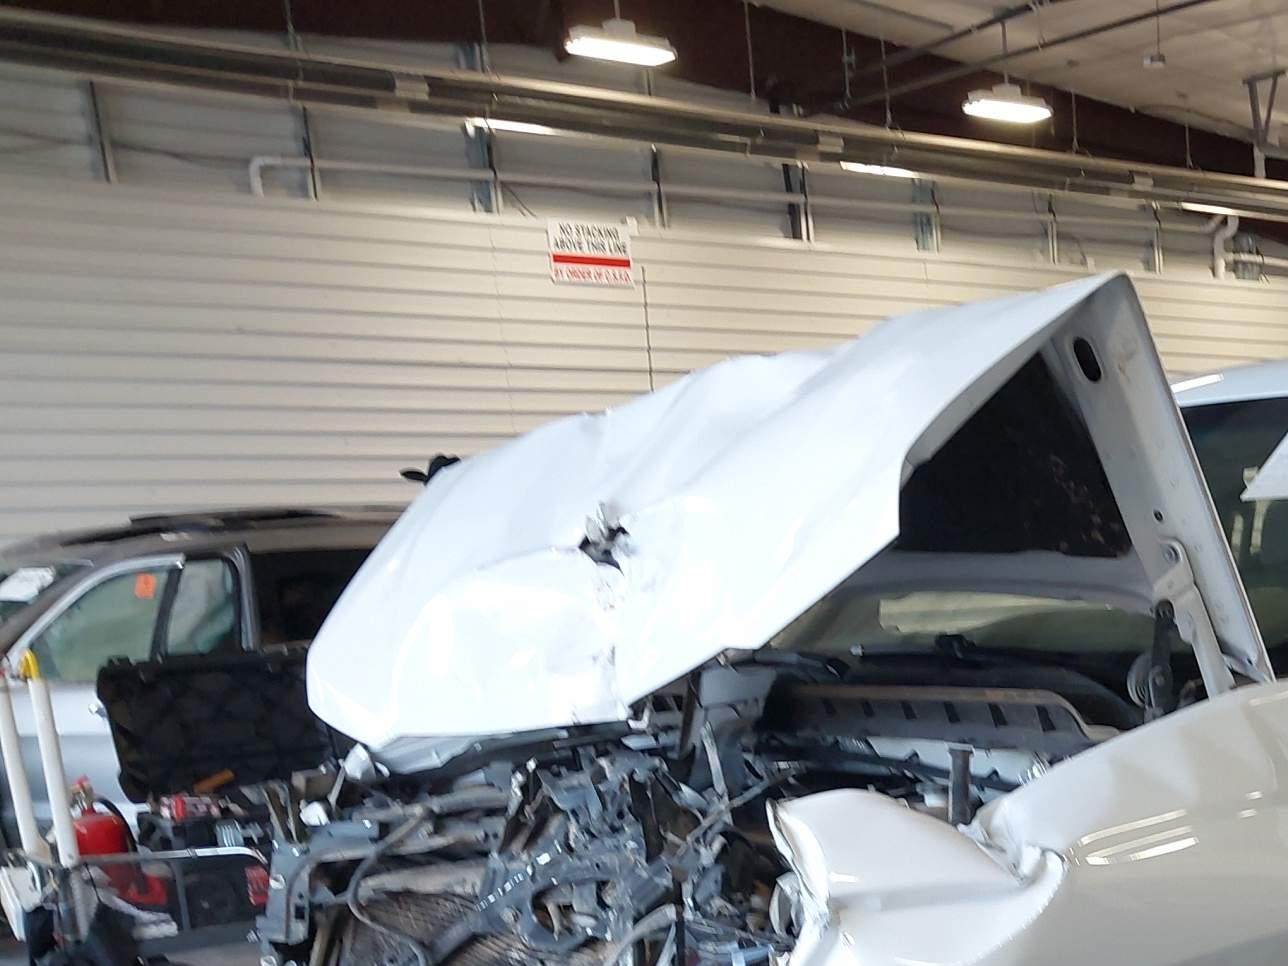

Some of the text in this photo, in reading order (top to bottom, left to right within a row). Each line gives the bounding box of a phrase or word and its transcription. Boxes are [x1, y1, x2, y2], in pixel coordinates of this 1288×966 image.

[559, 223, 620, 241] NO STACKING
[555, 236, 627, 256] ABOVE THIS LINE
